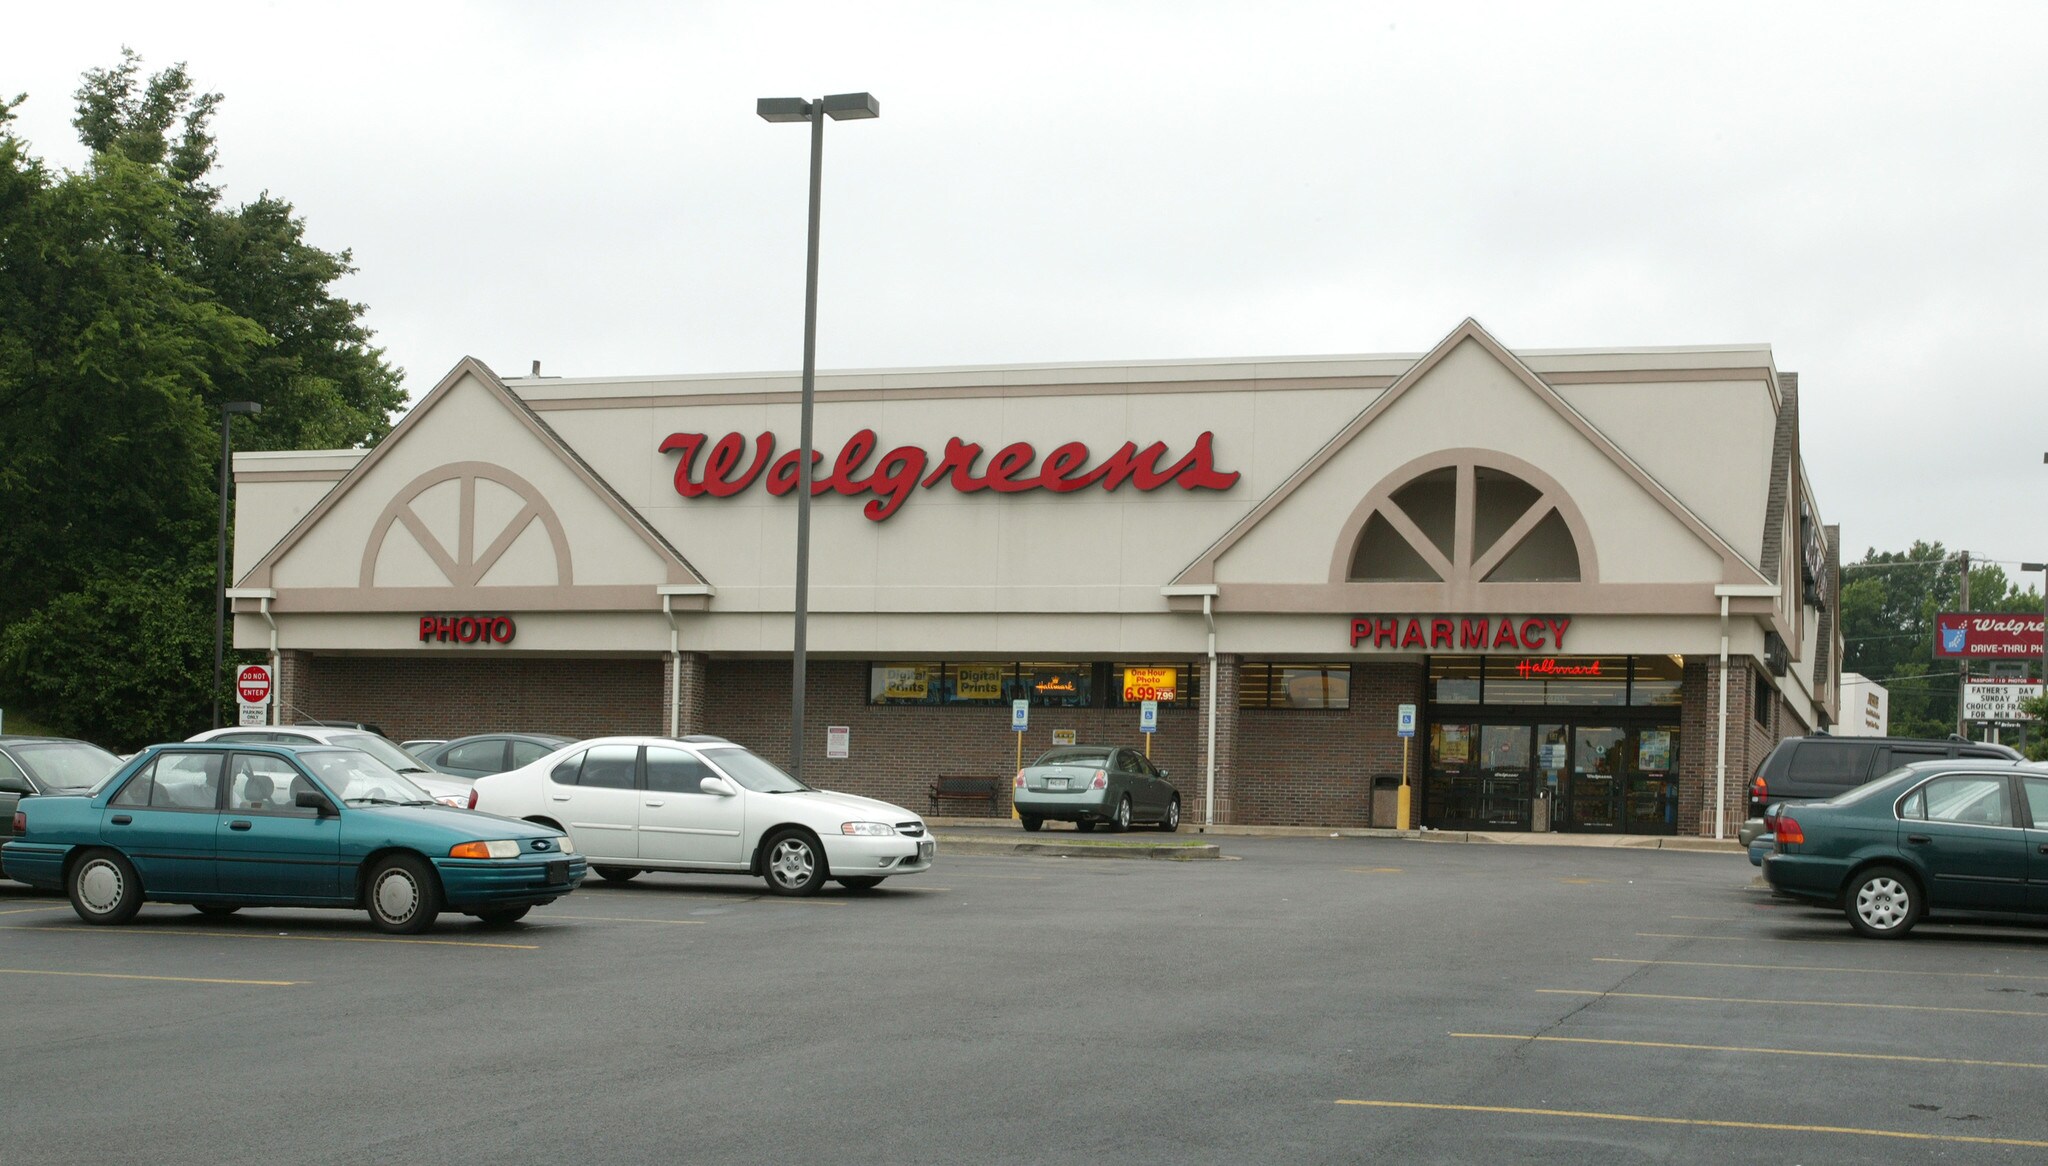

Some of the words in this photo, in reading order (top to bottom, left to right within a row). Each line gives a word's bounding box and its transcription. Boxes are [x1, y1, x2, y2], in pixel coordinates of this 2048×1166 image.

[658, 428, 1241, 521] Walgreens
[419, 616, 515, 643] PHOTO
[1350, 618, 1571, 649] PHARMACY
[1973, 619, 2044, 636] Walgre
[1970, 644, 2027, 653] DRIVE-THRU
[2030, 644, 2044, 653] PH
[1515, 658, 1602, 680] Hallmark
[887, 670, 926, 682] Digital
[960, 670, 999, 682] Digital
[888, 681, 924, 692] Prints
[961, 682, 997, 693] Prints
[1035, 681, 1076, 693] Hallmark
[2018, 687, 2035, 695] DAY
[1125, 687, 1155, 701] 6.99
[1156, 691, 1174, 700] 7.99
